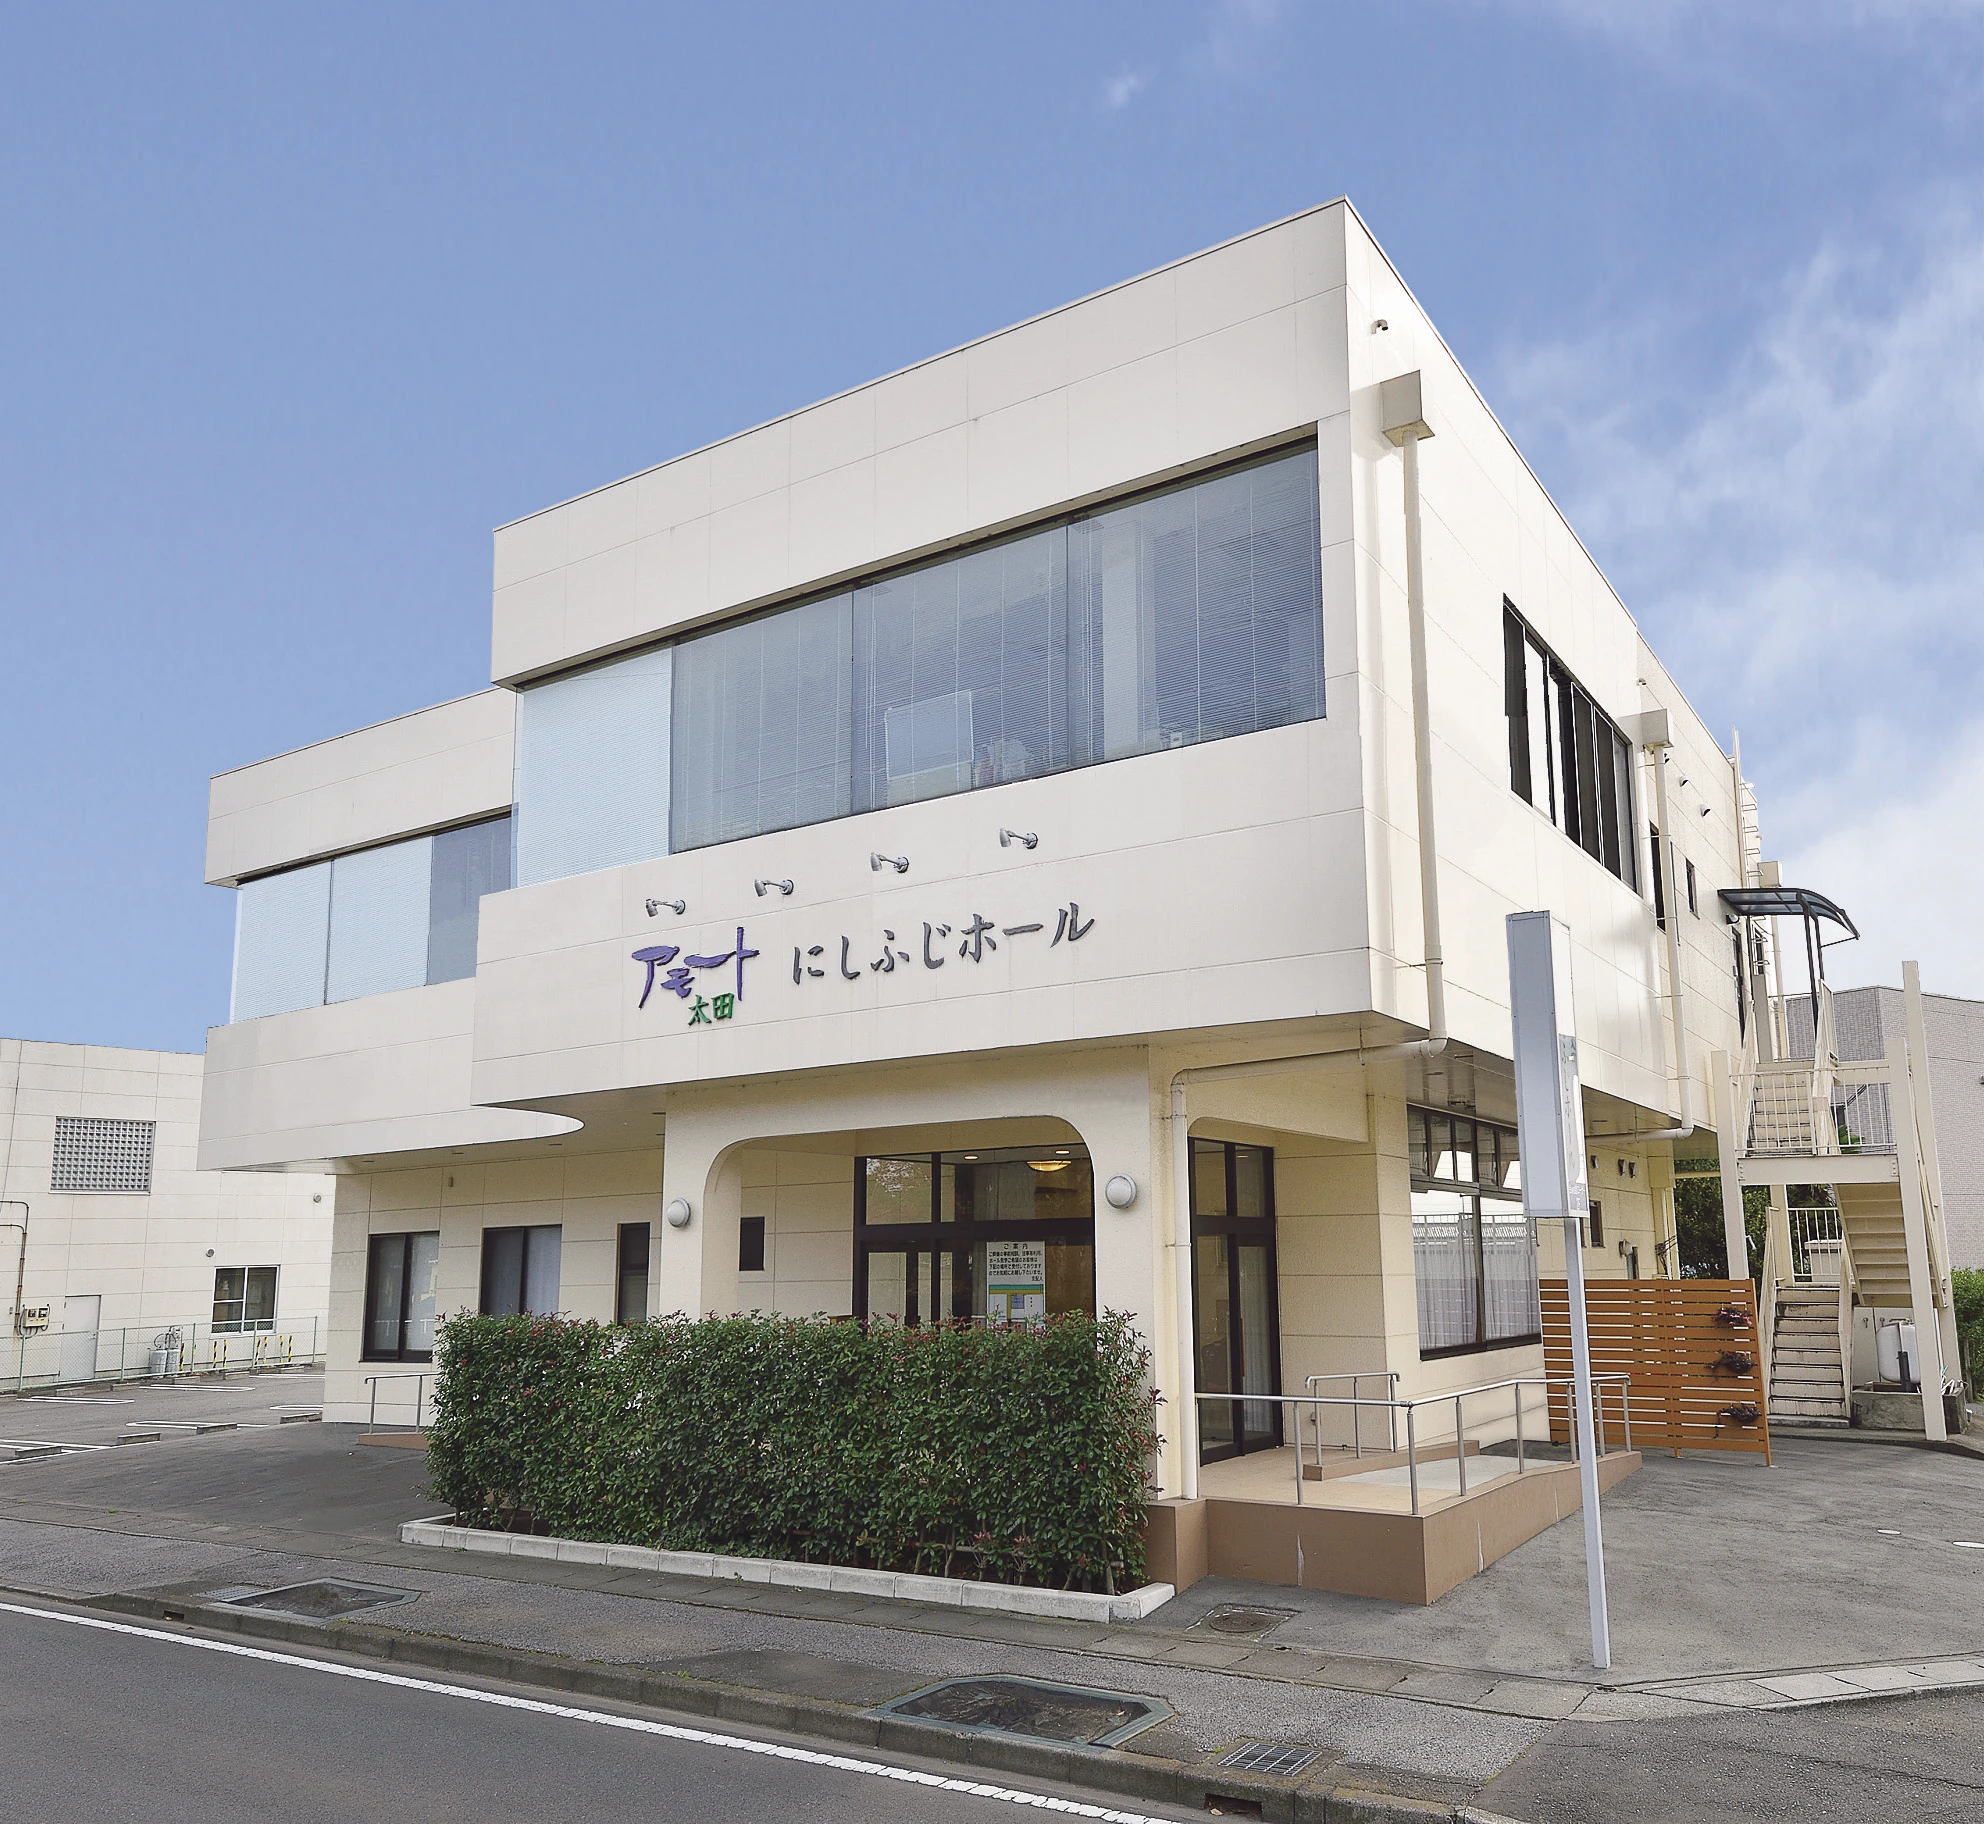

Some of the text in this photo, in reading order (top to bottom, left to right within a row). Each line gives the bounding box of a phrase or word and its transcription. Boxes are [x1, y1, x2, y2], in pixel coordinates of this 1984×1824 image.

[792, 902, 1095, 985] にしふじホール
[687, 992, 734, 1026] 太田
